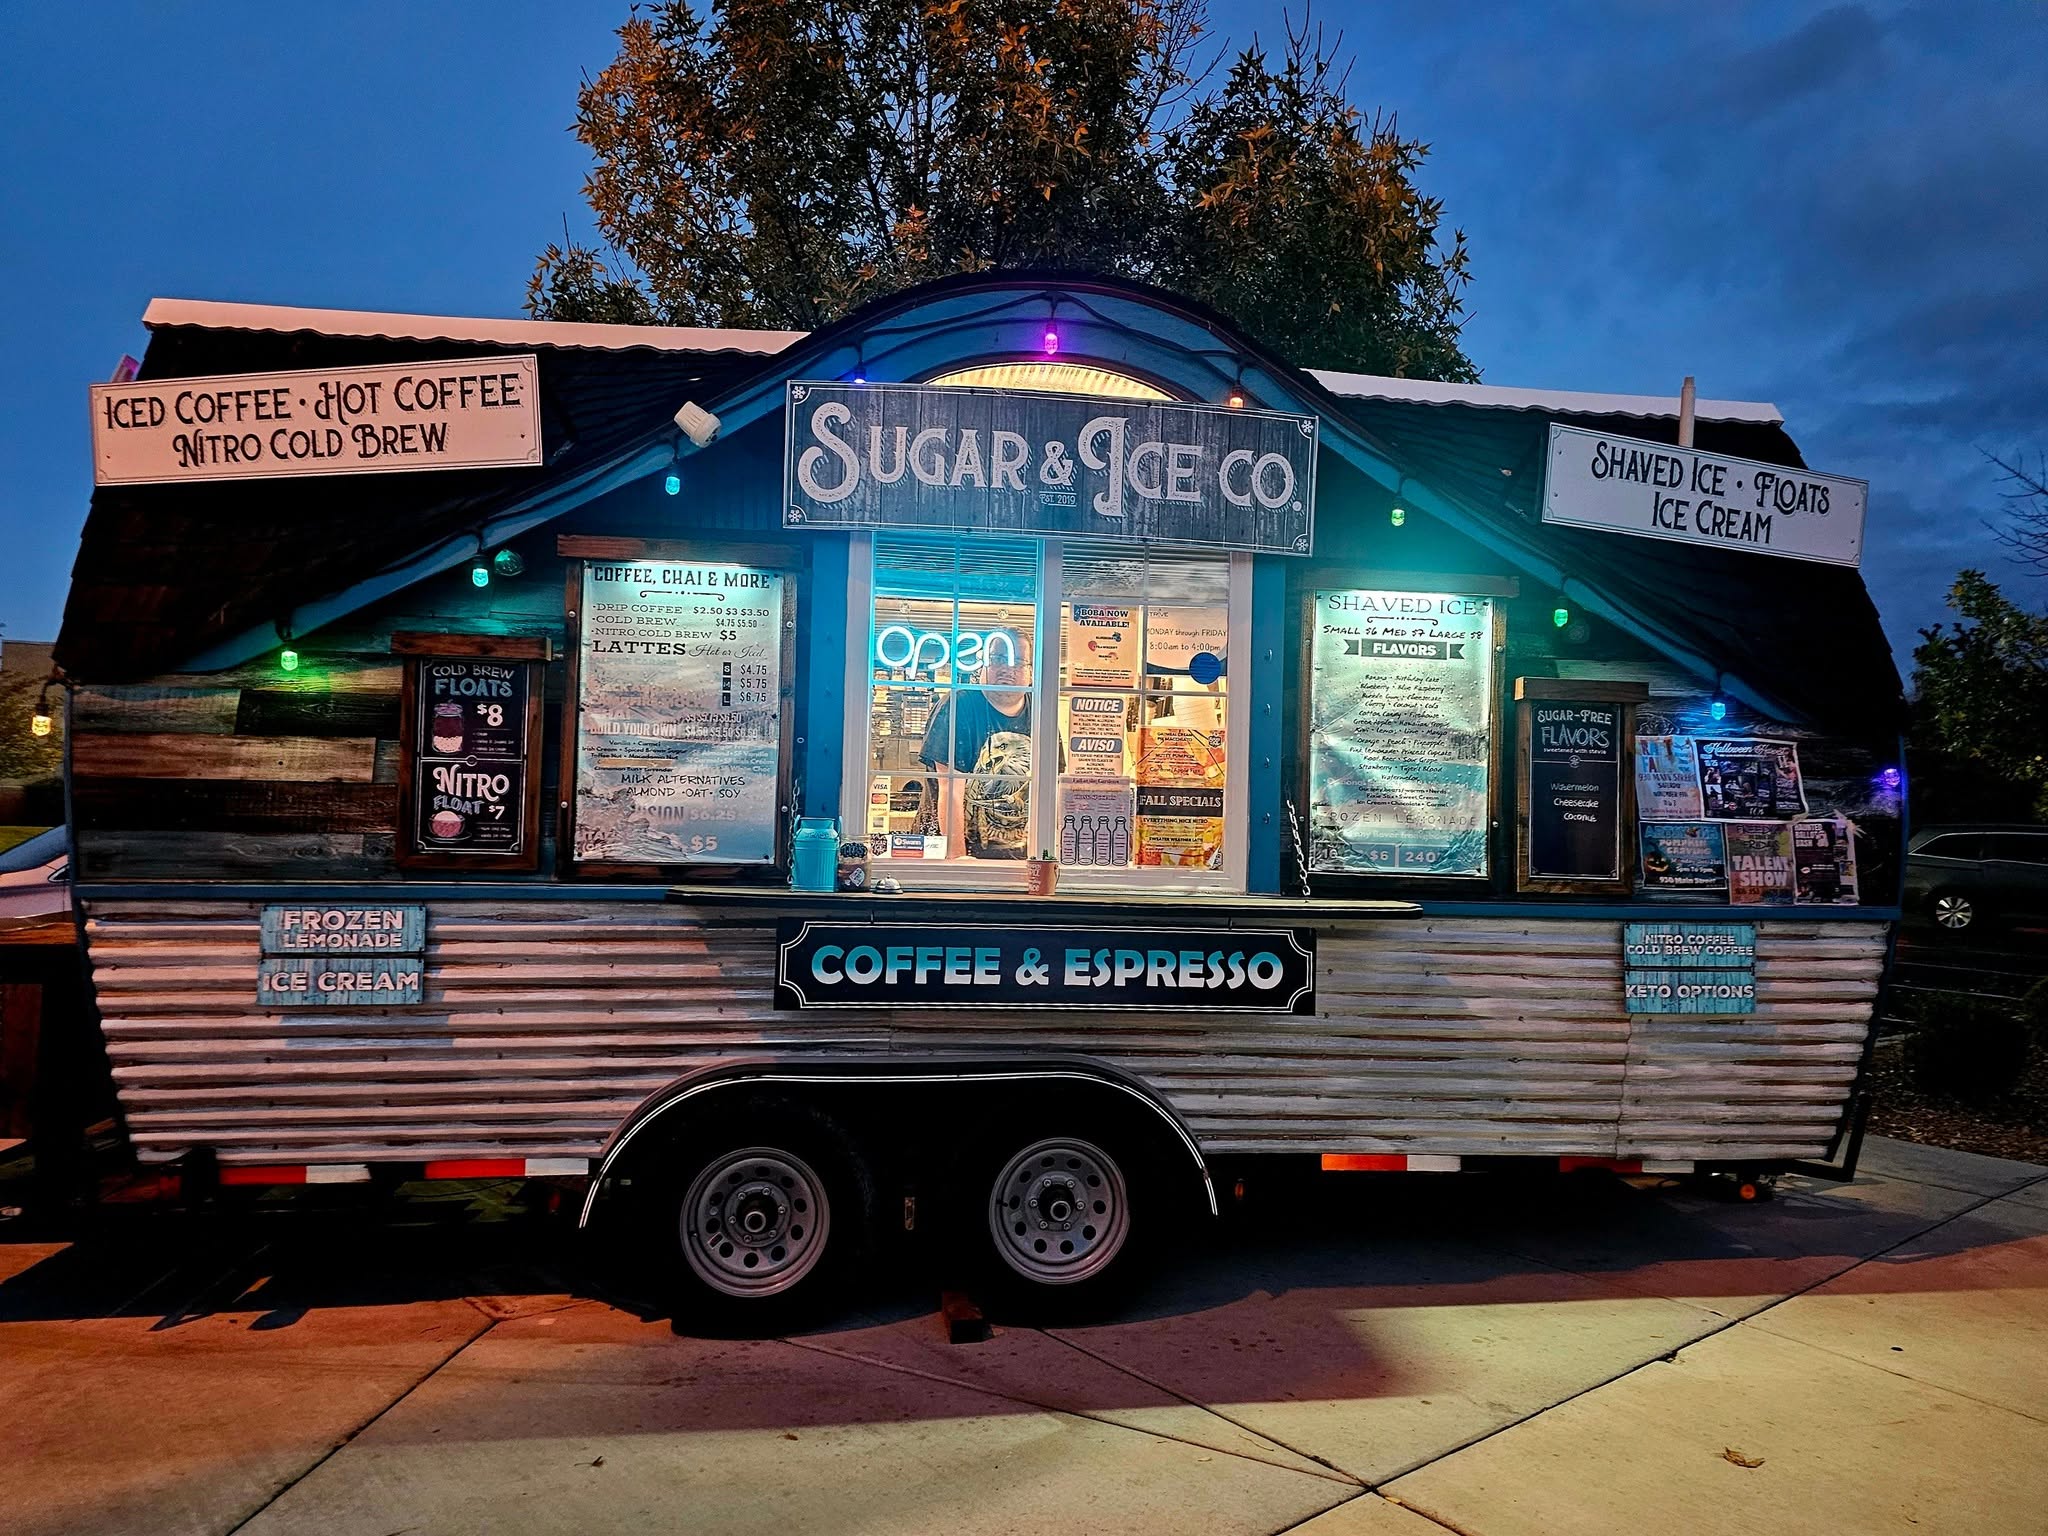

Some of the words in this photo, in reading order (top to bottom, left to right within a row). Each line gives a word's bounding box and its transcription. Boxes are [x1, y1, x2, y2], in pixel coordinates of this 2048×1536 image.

[104, 395, 166, 430] ICED
[174, 388, 294, 425] COFFEE
[315, 381, 384, 425] HOT
[394, 373, 523, 412] COFFEE
[172, 428, 263, 468] NITRO
[270, 428, 344, 461] COLD
[351, 422, 449, 459] BREW
[797, 401, 1030, 504] SUGAR
[1039, 440, 1075, 486] &
[1077, 416, 1203, 518] ICE
[1218, 448, 1304, 513] CO.
[1591, 440, 1684, 489] SHAVED
[1691, 457, 1728, 497] ICE
[1753, 471, 1831, 516] FLOATS
[1057, 495, 1076, 505] 2019
[1652, 491, 1691, 532] ICE
[1695, 499, 1773, 545] CREAM
[594, 566, 657, 586] COFFEE,
[662, 569, 702, 586] CHAI
[708, 571, 718, 587] &
[724, 572, 770, 589] MORE
[597, 604, 628, 613] DRIP
[631, 605, 683, 614] COFFEE
[693, 607, 723, 616] $2.50
[725, 608, 738, 616] $3
[740, 608, 770, 617] $3.50
[1328, 594, 1433, 613] SHAVED
[1440, 600, 1478, 616] ICE
[1081, 608, 1105, 617] BOBA
[1106, 610, 1129, 618] NOW
[596, 616, 633, 625] COLD
[715, 618, 736, 628] $4.75
[1079, 619, 1130, 628] AVAILABLE!
[595, 628, 636, 637] NITRO
[638, 629, 672, 639] COLD
[675, 630, 713, 639] BREW
[719, 630, 738, 642] $5
[1175, 629, 1200, 638] through
[1201, 629, 1227, 637] FRIDAY
[1323, 625, 1361, 635] SMALL
[1382, 628, 1407, 637] MED
[1429, 628, 1466, 640] LARGE
[592, 640, 687, 656] LATTES
[1181, 643, 1190, 651] to
[1191, 642, 1221, 652] 4:00pm
[1372, 642, 1438, 657] FLAVORS
[432, 665, 467, 677] COLD
[472, 665, 515, 678] BREW
[740, 664, 768, 676] $4.75
[434, 678, 514, 697] FLOATS
[740, 678, 768, 690] $5.75
[739, 691, 767, 703] $6.75
[1075, 698, 1121, 712] NOTICE
[476, 703, 504, 727] $8
[1537, 709, 1613, 725] SUGAR-FREE
[624, 722, 651, 736] YOUR
[652, 723, 678, 737] OWN
[1540, 725, 1610, 748] FLAVORS
[1077, 738, 1116, 752] AVISO
[1703, 741, 1753, 755] Halloween
[432, 764, 511, 802] NITRO
[621, 774, 653, 784] MILK
[657, 774, 746, 786] ALTERNATIVES
[1550, 782, 1600, 792] Watermelon
[626, 787, 676, 797] ALMOND
[718, 789, 741, 799] SOY
[432, 795, 485, 815] FLOAT
[488, 805, 506, 820] $7
[1139, 795, 1168, 806] FALL
[1169, 795, 1222, 808] SPECIALS
[1553, 797, 1600, 808] Cheesecake
[1563, 812, 1598, 823] Coconut
[690, 834, 718, 851] $5
[1369, 851, 1389, 861] $6
[1731, 855, 1791, 871] TALENT
[1740, 871, 1788, 887] SHOW
[283, 910, 404, 931] FROZEN
[282, 933, 403, 948] LEMONADE
[1645, 934, 1684, 945] NITRO
[1687, 935, 1736, 946] COFFEE
[1626, 945, 1661, 955] COLD
[1664, 945, 1702, 956] BREW
[1705, 945, 1754, 956] COFFEE
[810, 944, 1002, 986] COFFEE
[1014, 946, 1050, 987] &
[1062, 947, 1285, 991] ESPRESSO
[262, 972, 309, 992] ICE
[317, 971, 419, 992] CREAM
[1625, 984, 1672, 998] KETO
[1676, 984, 1755, 999] OPTIONS
